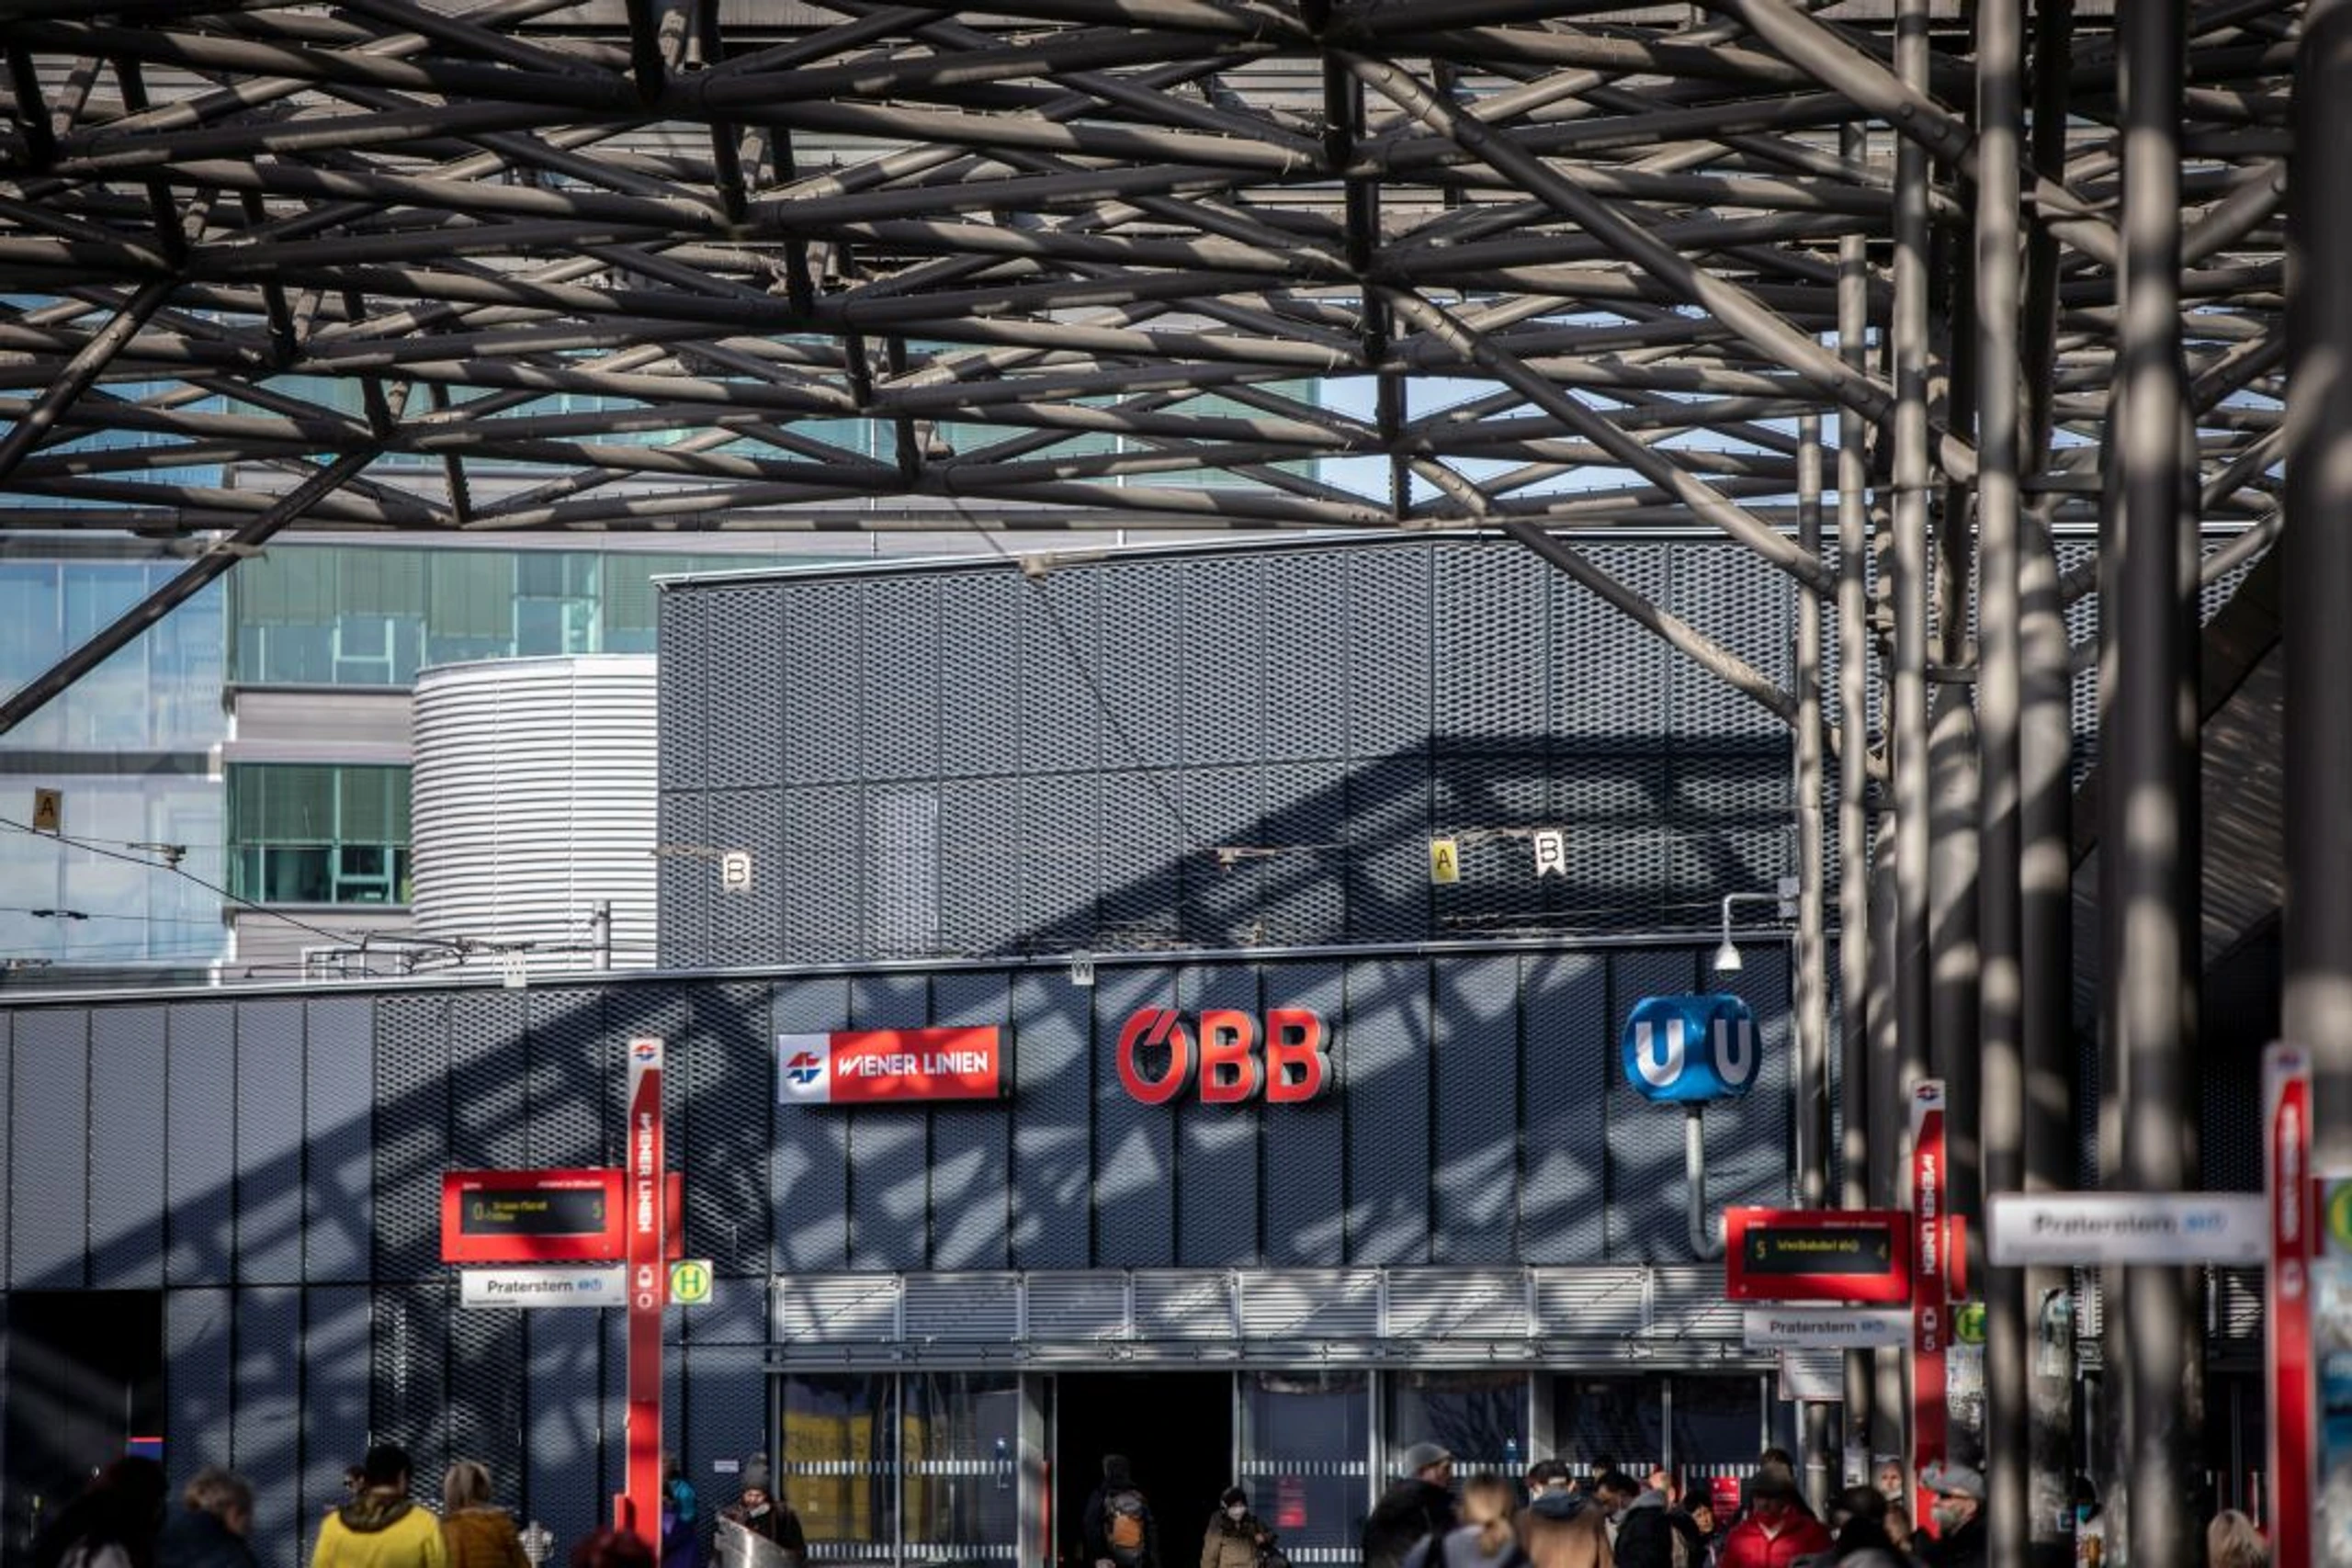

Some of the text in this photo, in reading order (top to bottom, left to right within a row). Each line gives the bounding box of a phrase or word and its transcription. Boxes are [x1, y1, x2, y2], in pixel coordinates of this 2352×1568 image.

[40, 795, 53, 818] A
[1437, 849, 1452, 870] A
[1539, 838, 1559, 863] B
[727, 859, 745, 883] B
[838, 1051, 989, 1077] WIENER LINIEN
[1115, 1005, 1323, 1105] ÖBB
[1635, 1019, 1685, 1088] U
[1713, 1018, 1753, 1086] U
[637, 1112, 653, 1233] WIENER LINIEN
[487, 1279, 573, 1294] Praterstern
[681, 1269, 699, 1293] H
[1770, 1319, 1857, 1334] Praterstern
